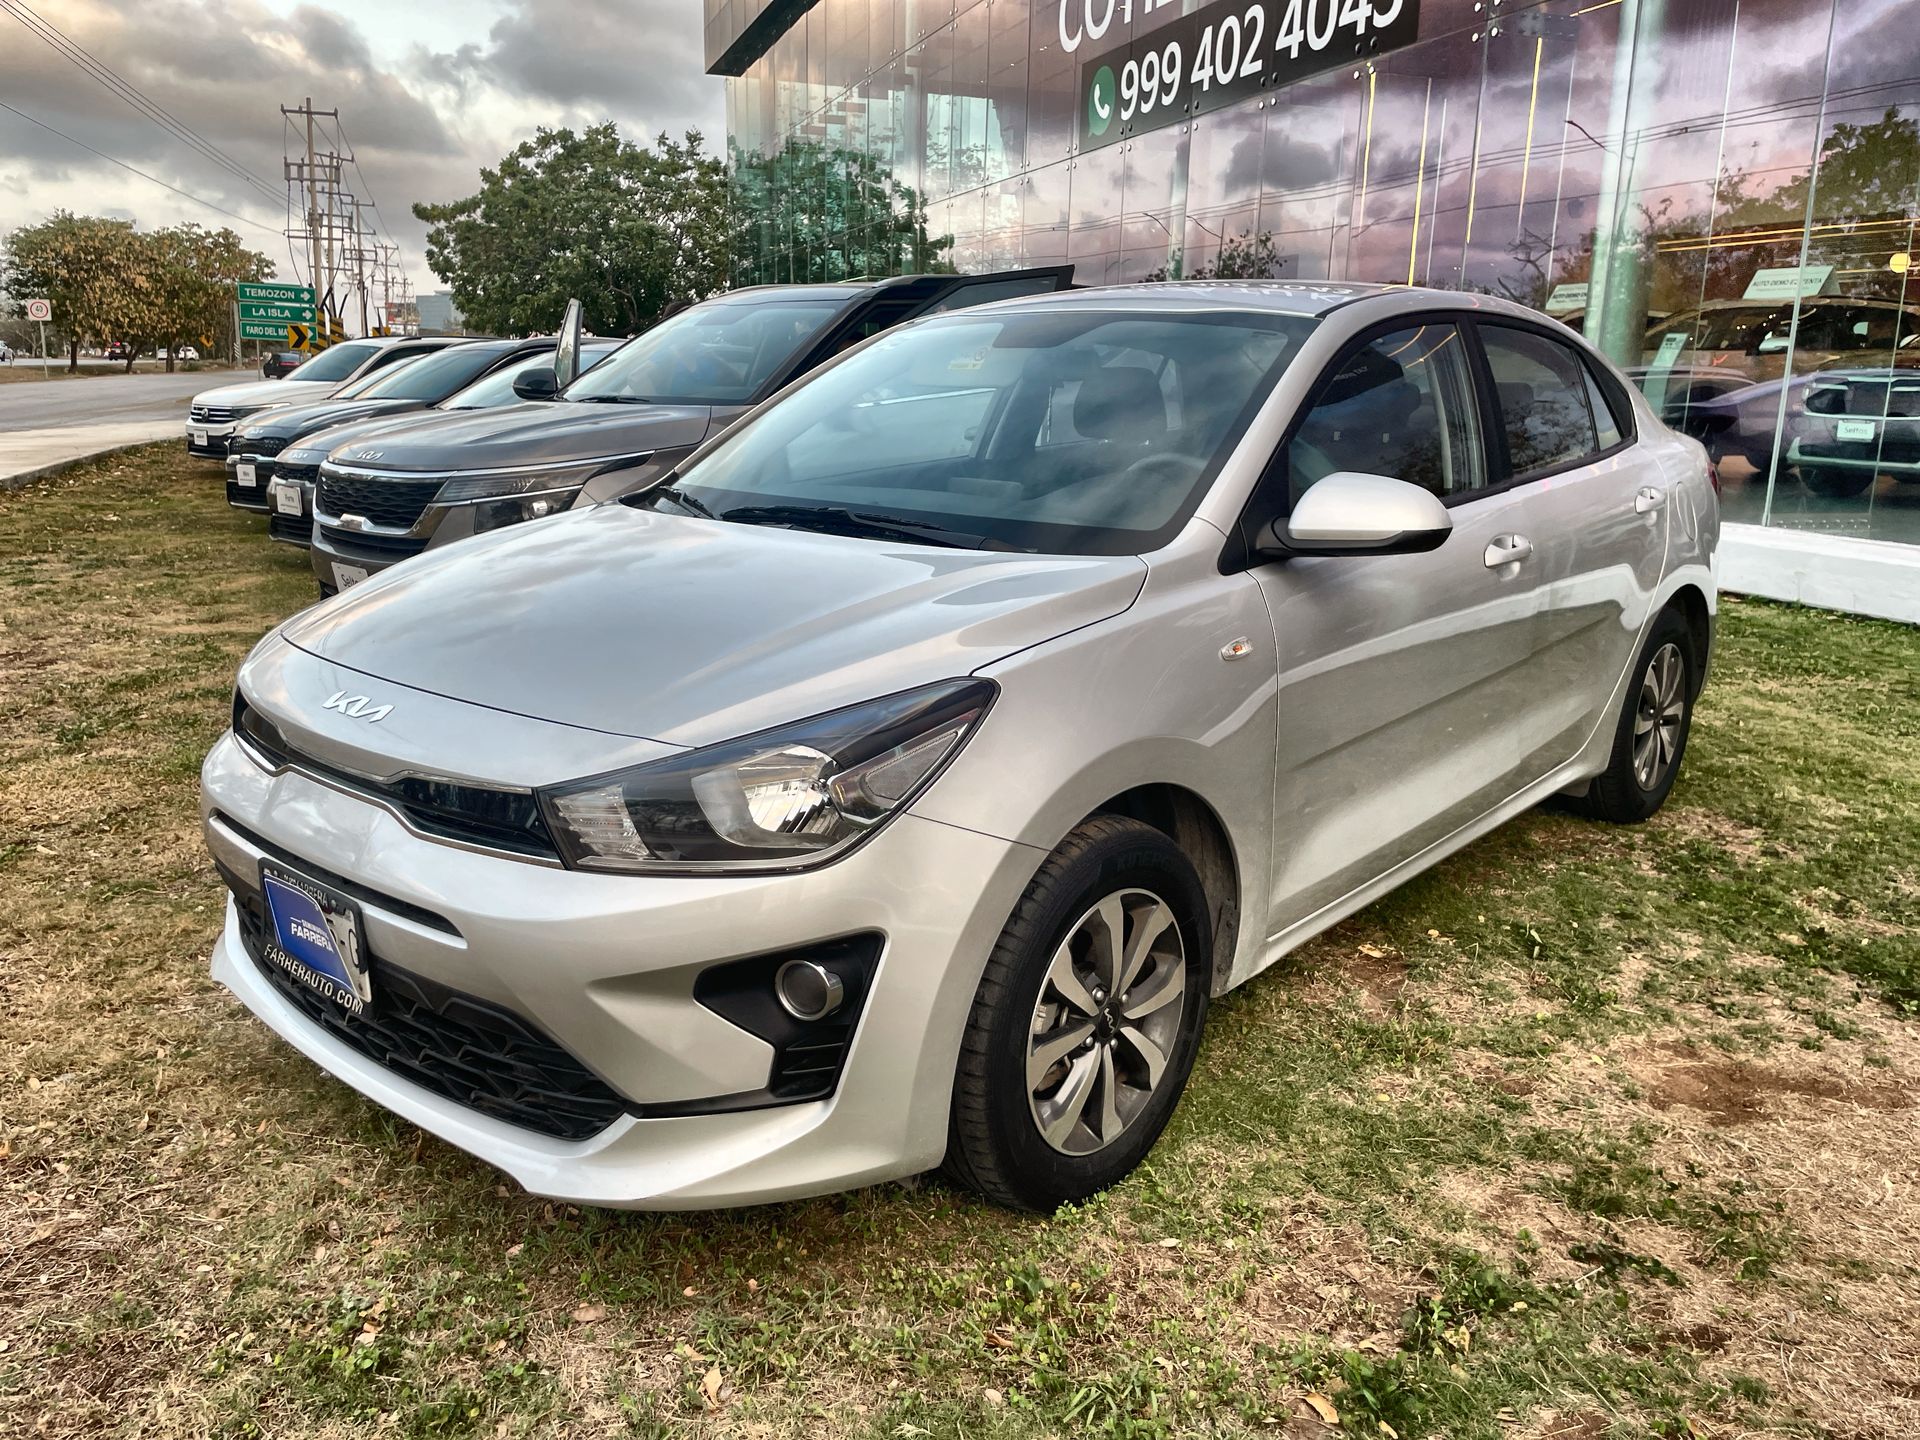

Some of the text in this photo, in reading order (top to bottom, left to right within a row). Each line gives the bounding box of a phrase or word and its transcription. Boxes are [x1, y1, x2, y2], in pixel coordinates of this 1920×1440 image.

[1120, 41, 1182, 121] 999
[1190, 4, 1265, 92] 402
[244, 287, 295, 299] TEMOZON
[252, 307, 291, 318] LA ISLA
[246, 326, 263, 335] FARO
[264, 327, 276, 336] DEL
[321, 690, 396, 724] KIA
